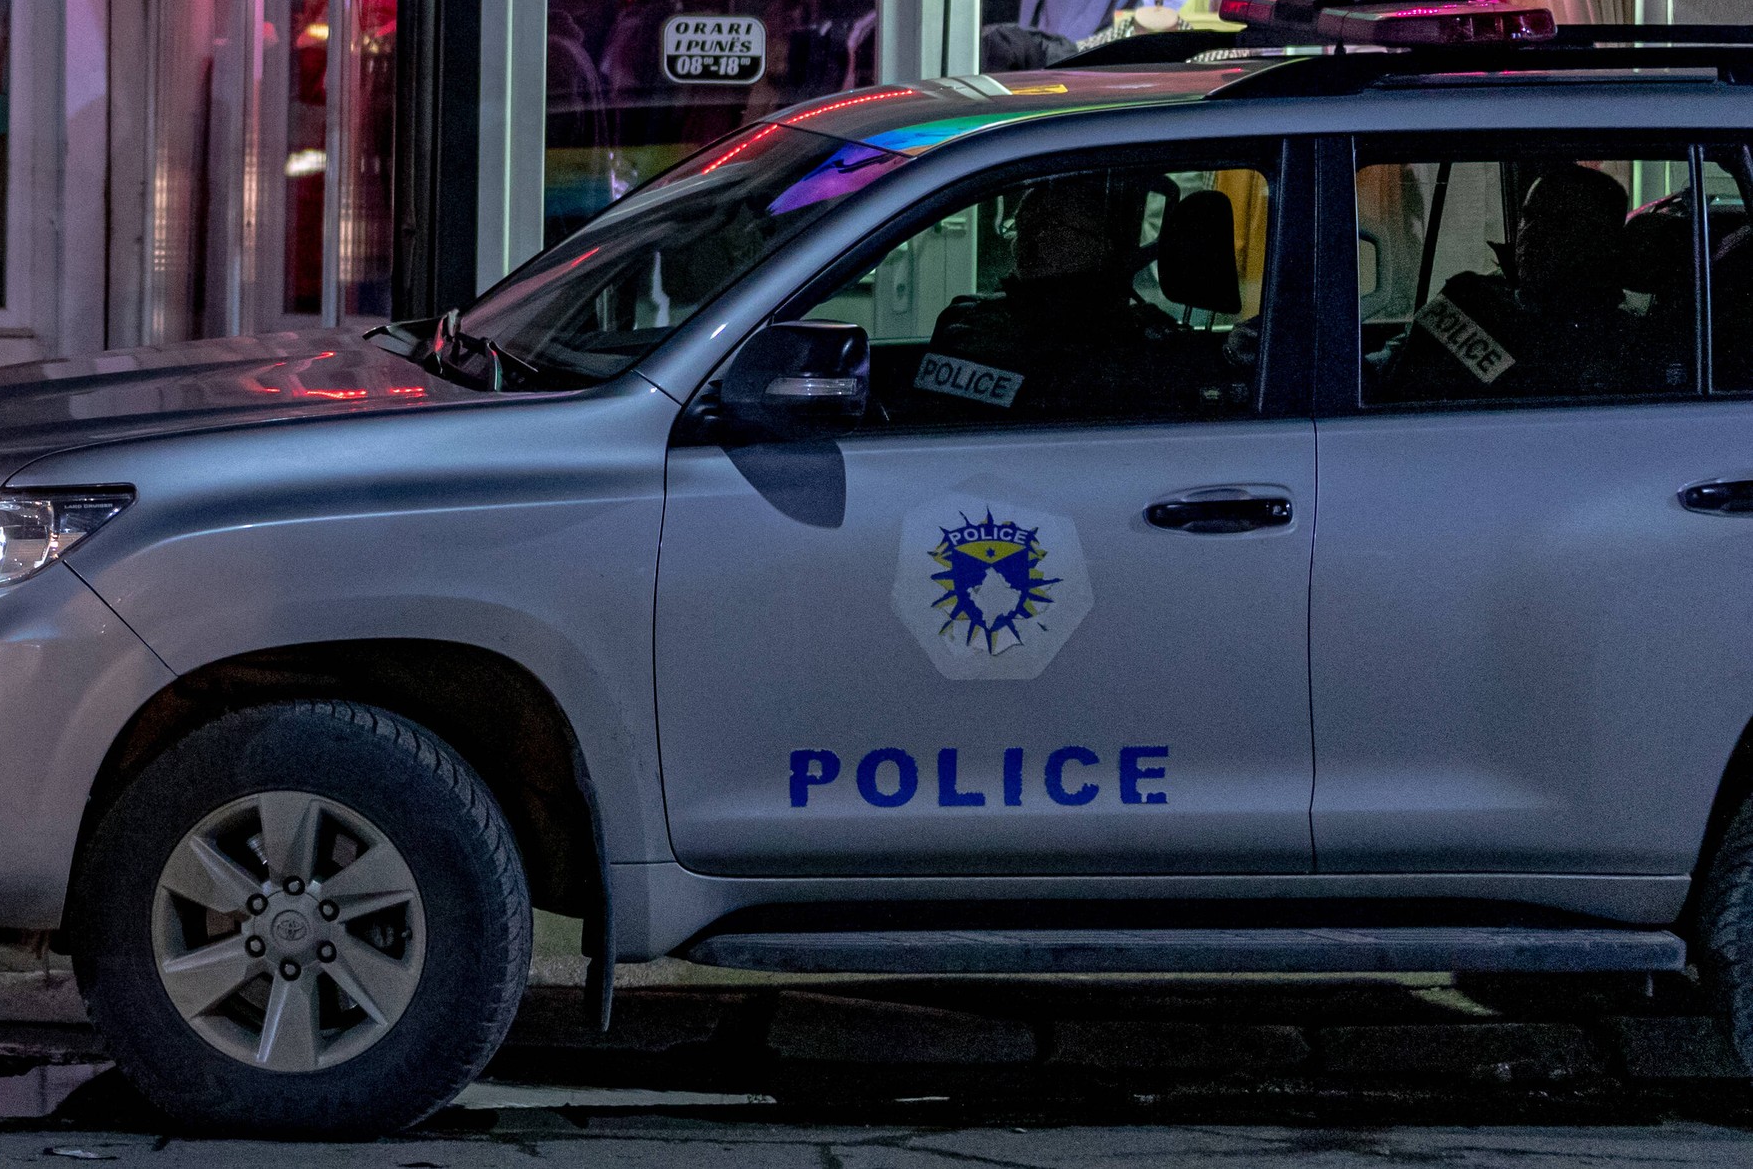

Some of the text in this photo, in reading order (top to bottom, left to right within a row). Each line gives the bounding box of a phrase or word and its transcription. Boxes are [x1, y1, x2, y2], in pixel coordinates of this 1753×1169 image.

[675, 22, 753, 35] ORARI
[686, 37, 752, 53] PUNËS
[1423, 300, 1502, 374] POLICE
[920, 358, 1013, 399] POLICE
[948, 527, 1029, 546] POLICE
[788, 745, 1170, 809] POLICE
